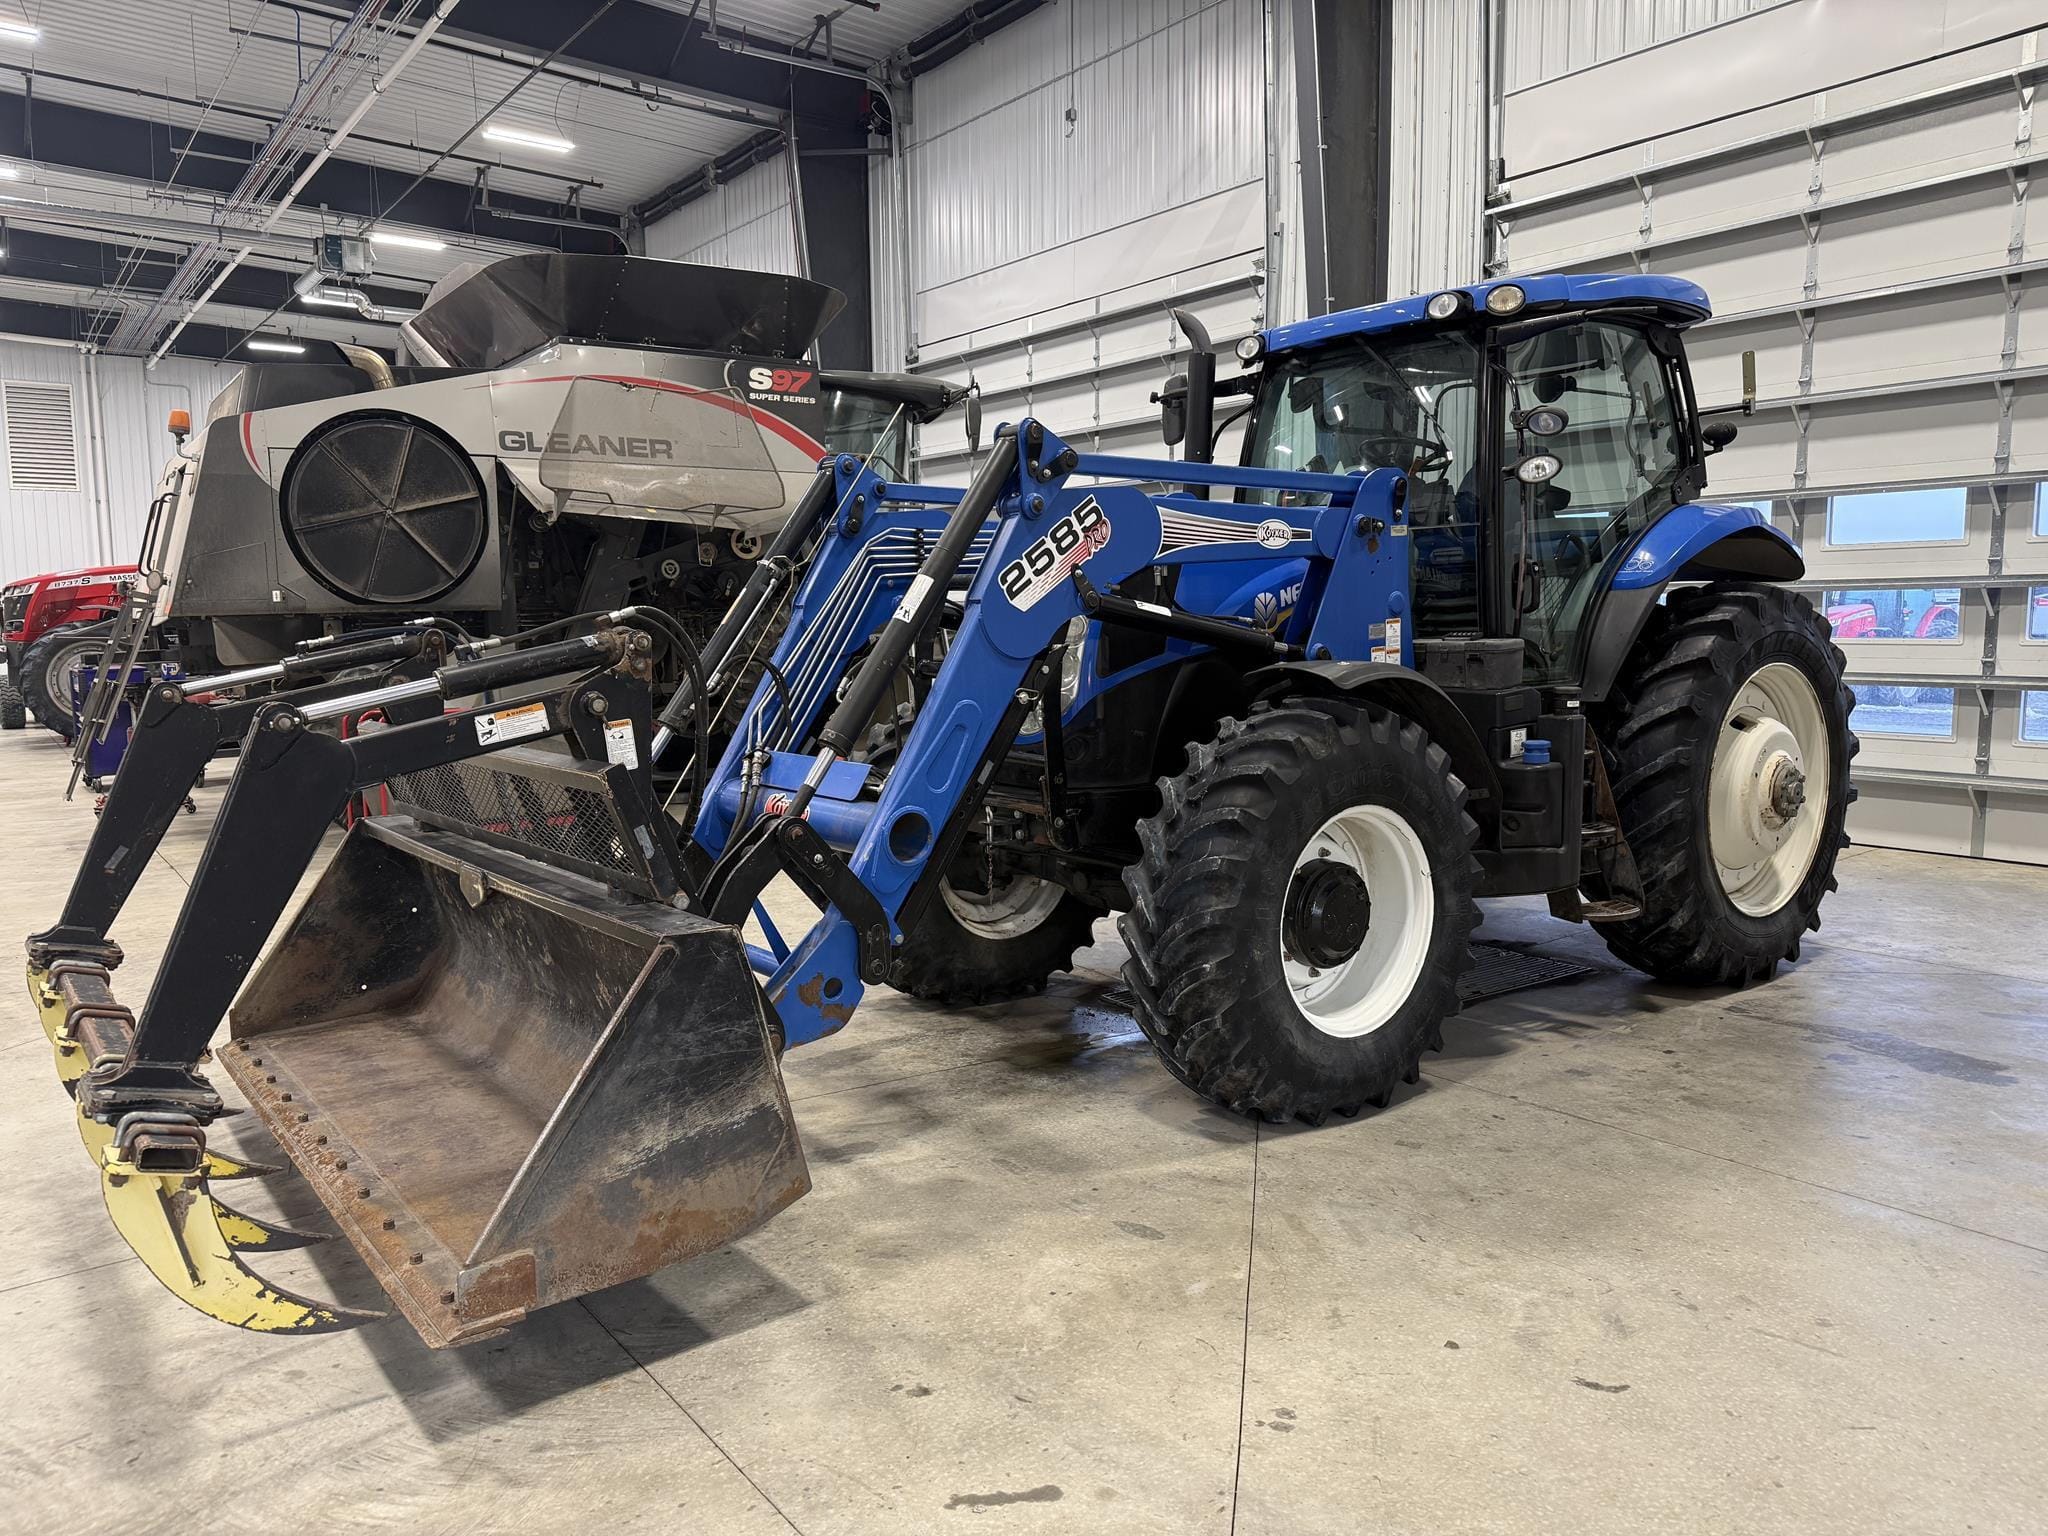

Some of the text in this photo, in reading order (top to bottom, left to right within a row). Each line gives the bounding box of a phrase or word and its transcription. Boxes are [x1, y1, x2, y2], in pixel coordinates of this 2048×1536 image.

[748, 367, 813, 393] S97
[749, 392, 816, 405] SUPER SERIES
[498, 430, 674, 460] GLEANER
[1000, 495, 1103, 601] 2585
[109, 574, 138, 582] MASSE
[1280, 582, 1303, 608] NE
